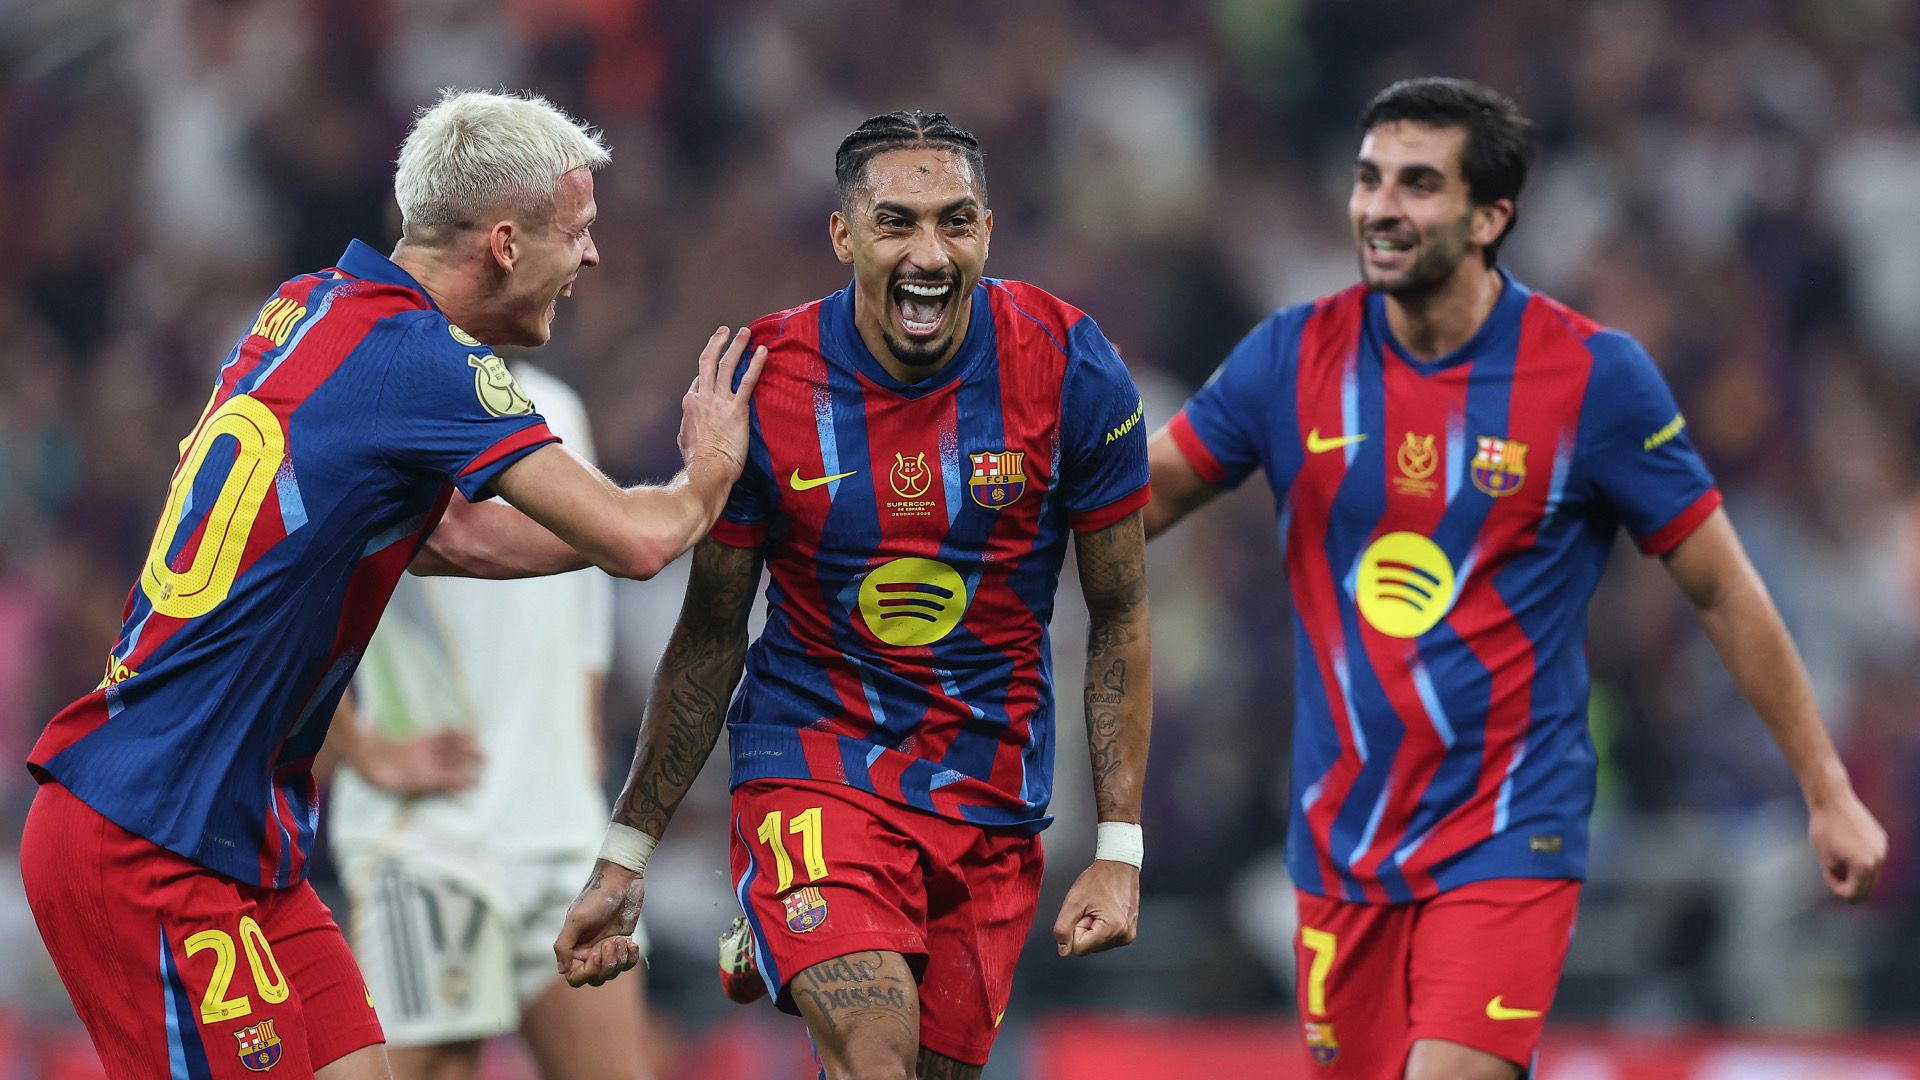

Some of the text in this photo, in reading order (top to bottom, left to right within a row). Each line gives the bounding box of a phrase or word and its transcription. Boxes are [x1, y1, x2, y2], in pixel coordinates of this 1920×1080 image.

[250, 297, 307, 347] OLMO
[141, 385, 285, 618] 0
[986, 475, 1009, 483] FCB
[757, 807, 829, 894] 11
[184, 915, 290, 1024] 20
[1301, 926, 1338, 1017] 7
[251, 1041, 269, 1053] FCB
